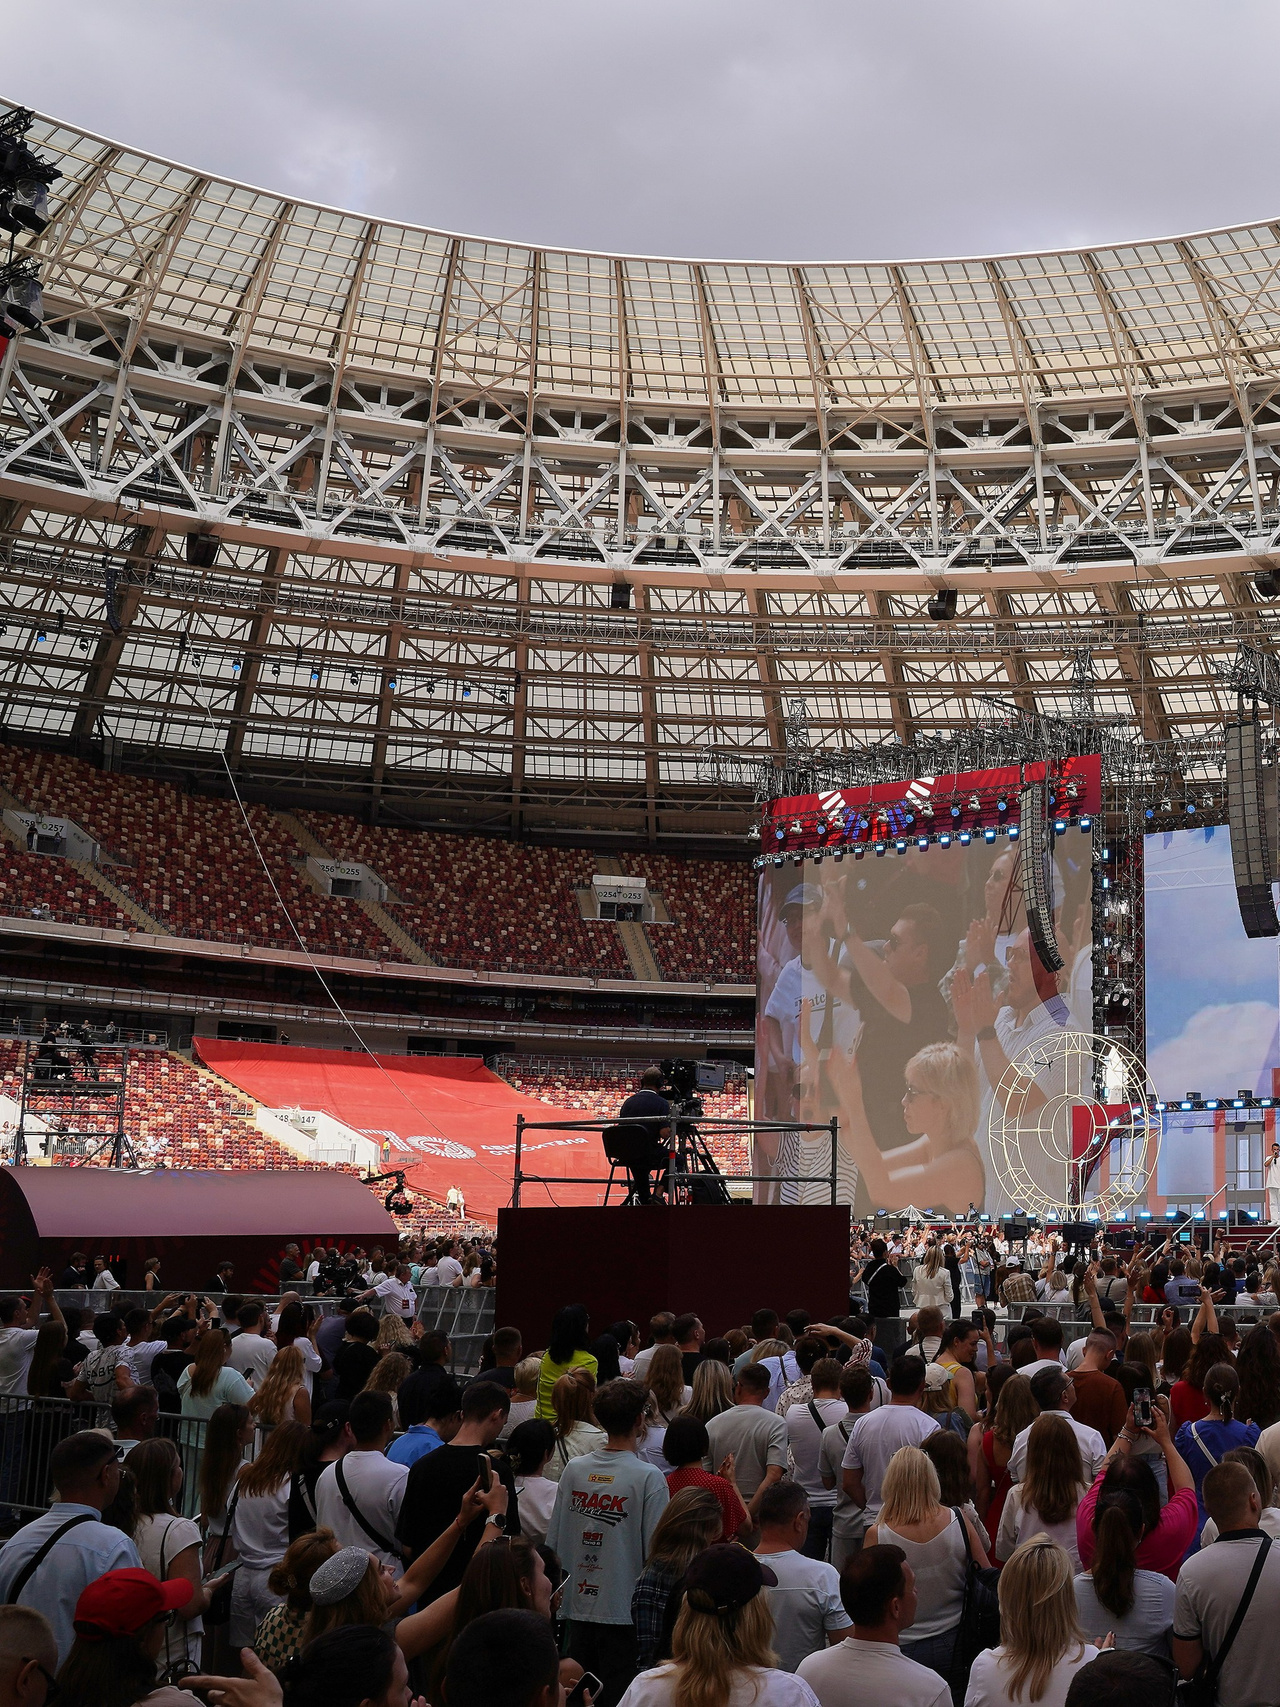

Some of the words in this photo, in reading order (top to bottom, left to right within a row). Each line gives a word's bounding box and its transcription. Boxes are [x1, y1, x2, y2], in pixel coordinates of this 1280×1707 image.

[48, 823, 65, 833] 257
[346, 868, 360, 876] 255
[572, 1490, 629, 1512] TRACK
